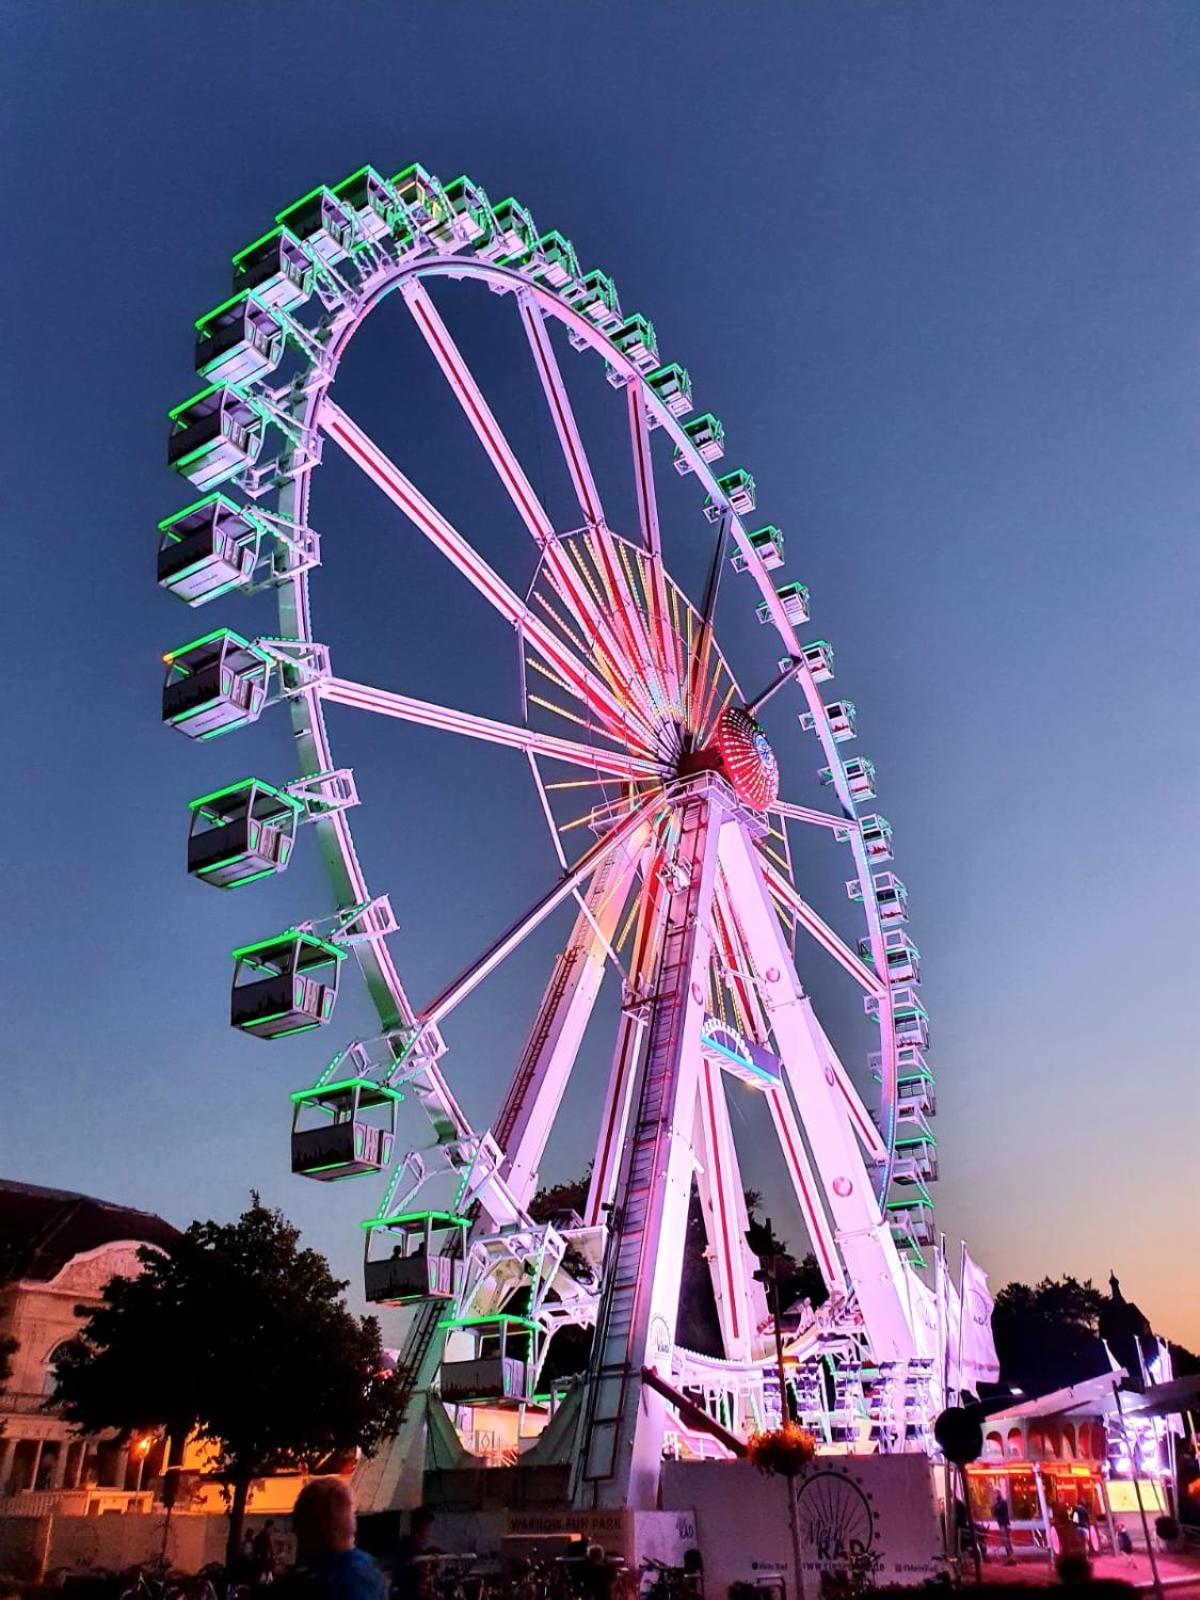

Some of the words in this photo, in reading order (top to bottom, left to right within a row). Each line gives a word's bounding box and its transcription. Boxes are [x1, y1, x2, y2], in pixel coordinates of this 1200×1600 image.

[565, 1517, 589, 1530] FUN
[592, 1517, 622, 1531] PARK
[817, 1538, 866, 1560] RAD
